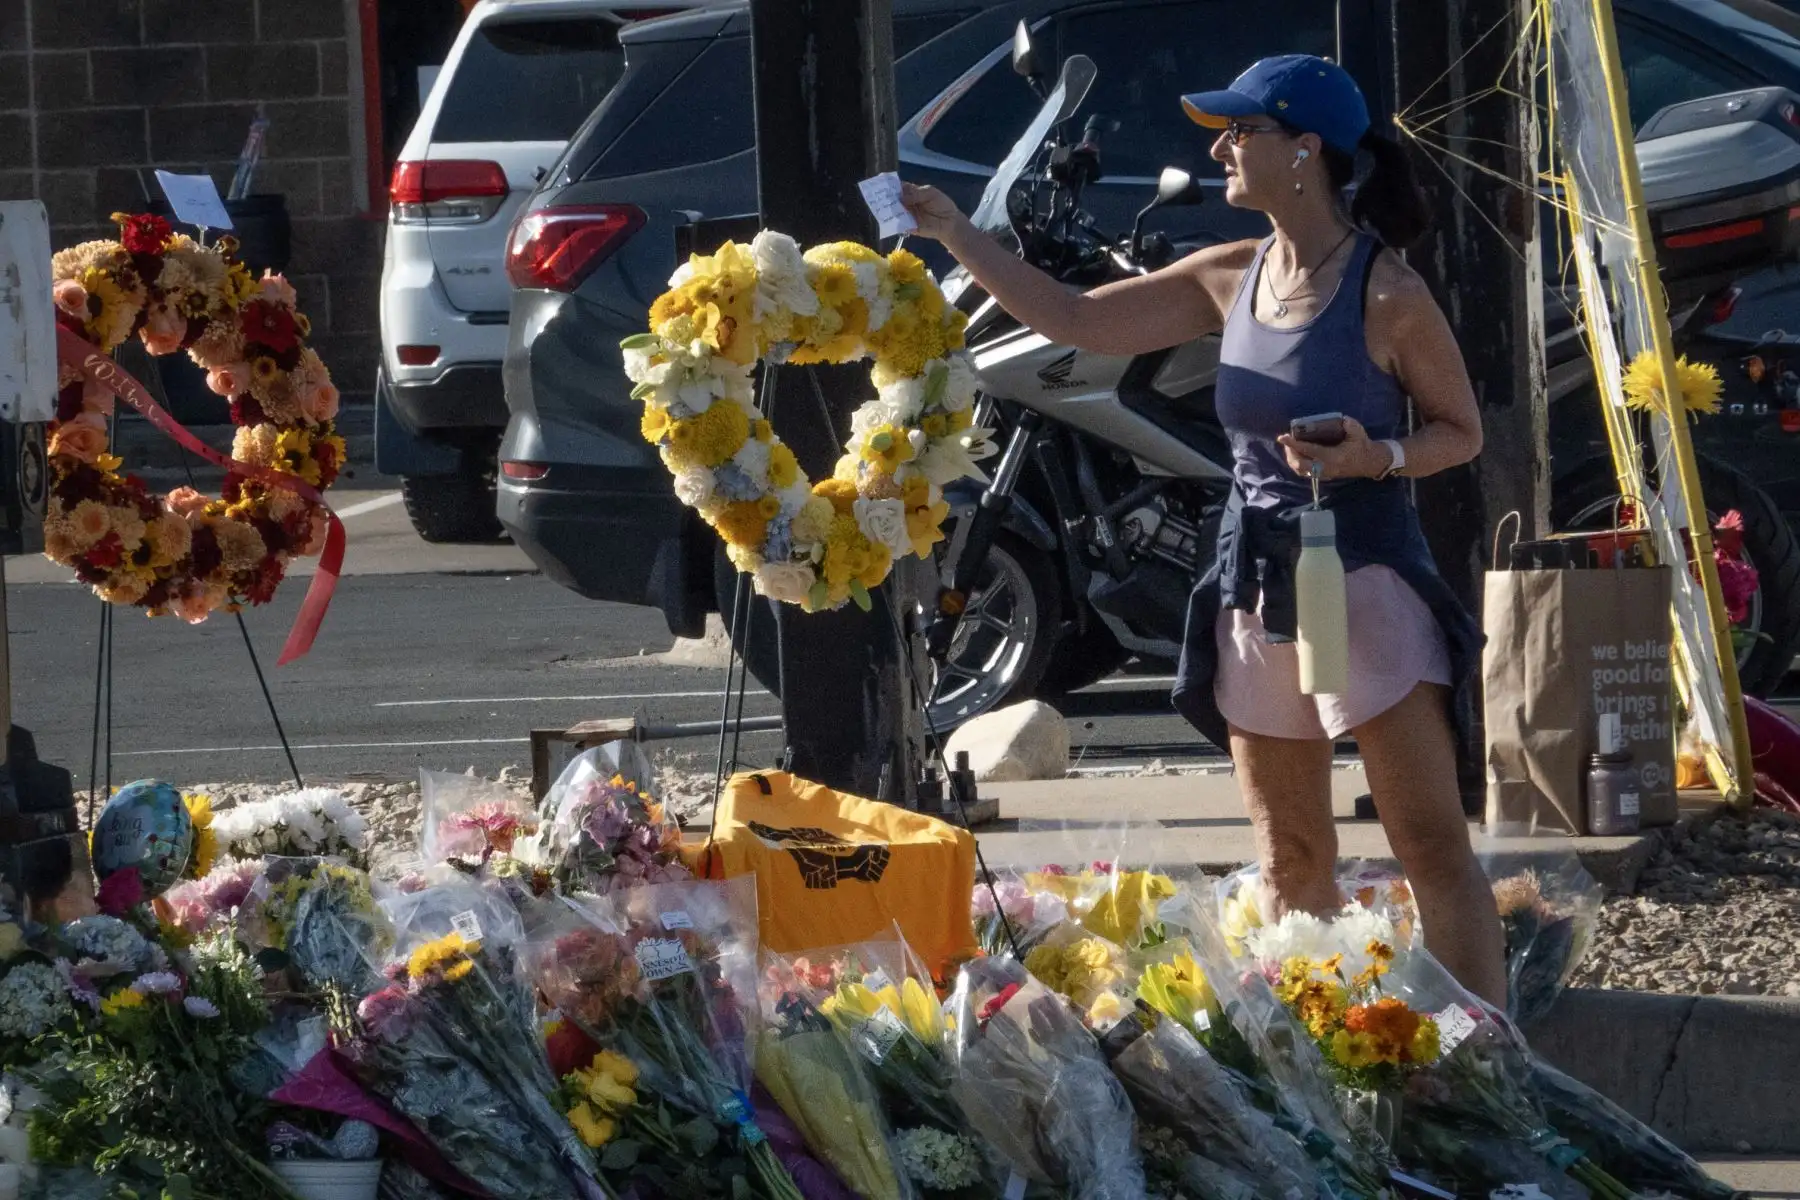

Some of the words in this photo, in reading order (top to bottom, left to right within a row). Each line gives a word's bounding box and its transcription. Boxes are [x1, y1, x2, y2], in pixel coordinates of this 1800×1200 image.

[1041, 380, 1089, 391] HONDA
[1592, 645, 1618, 660] we
[1624, 640, 1668, 660] belie
[1592, 663, 1640, 690] good
[1594, 691, 1657, 719] brings
[1620, 718, 1669, 747] gethe
